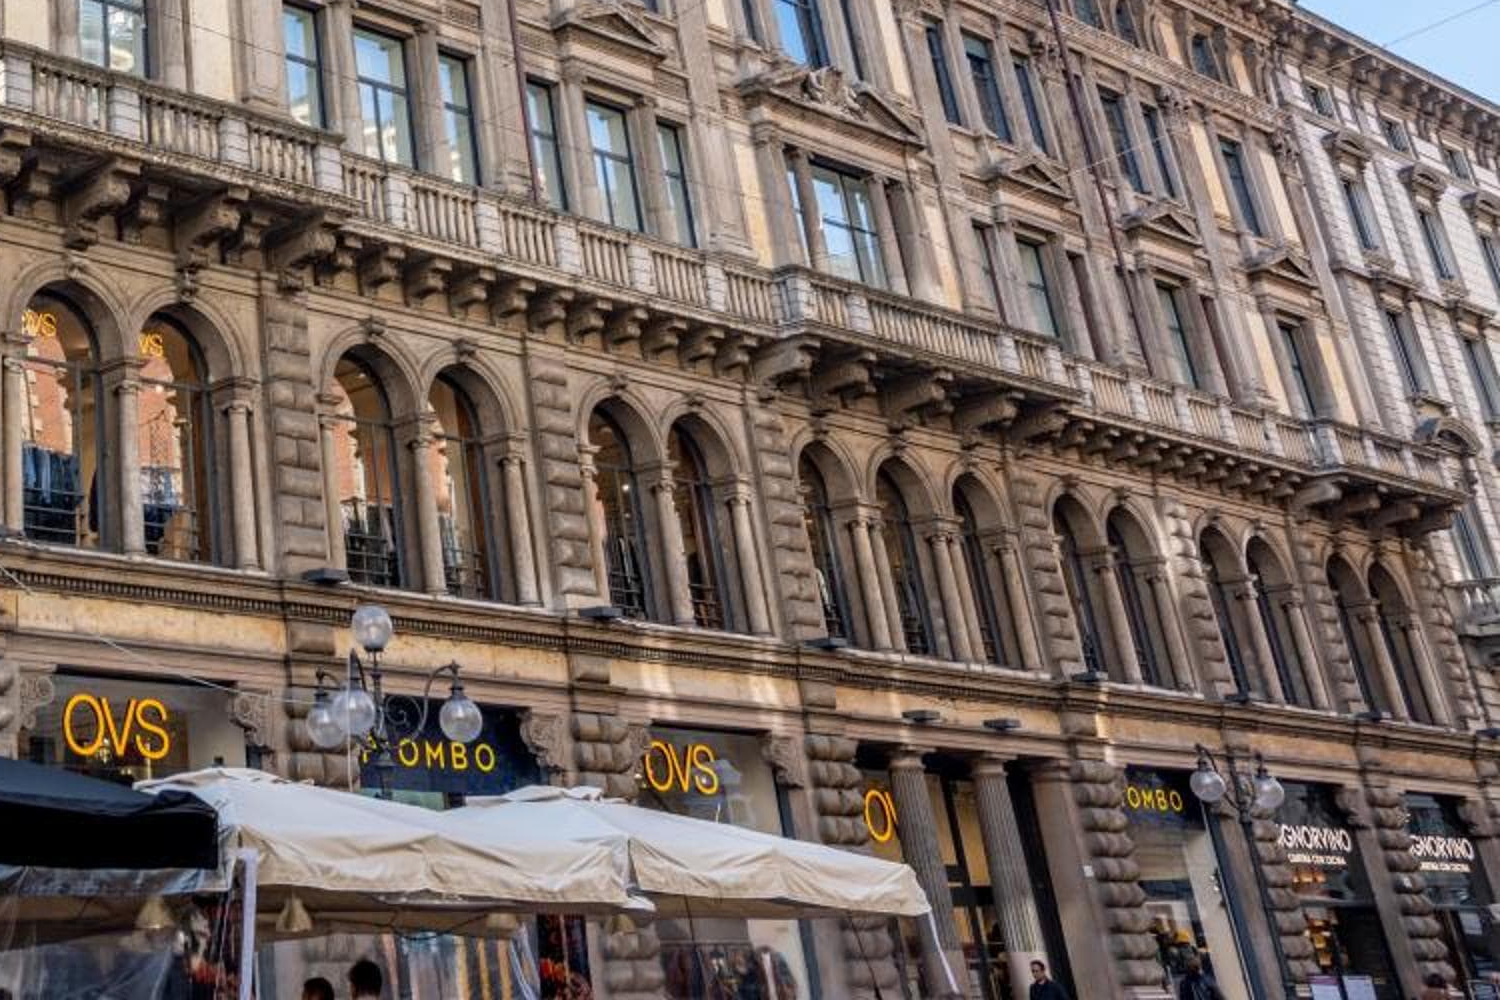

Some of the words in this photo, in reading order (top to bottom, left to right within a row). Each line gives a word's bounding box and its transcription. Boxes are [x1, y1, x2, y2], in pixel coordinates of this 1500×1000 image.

[63, 693, 170, 760] OVS
[644, 740, 719, 796] OVS
[1126, 785, 1184, 812] OMBO
